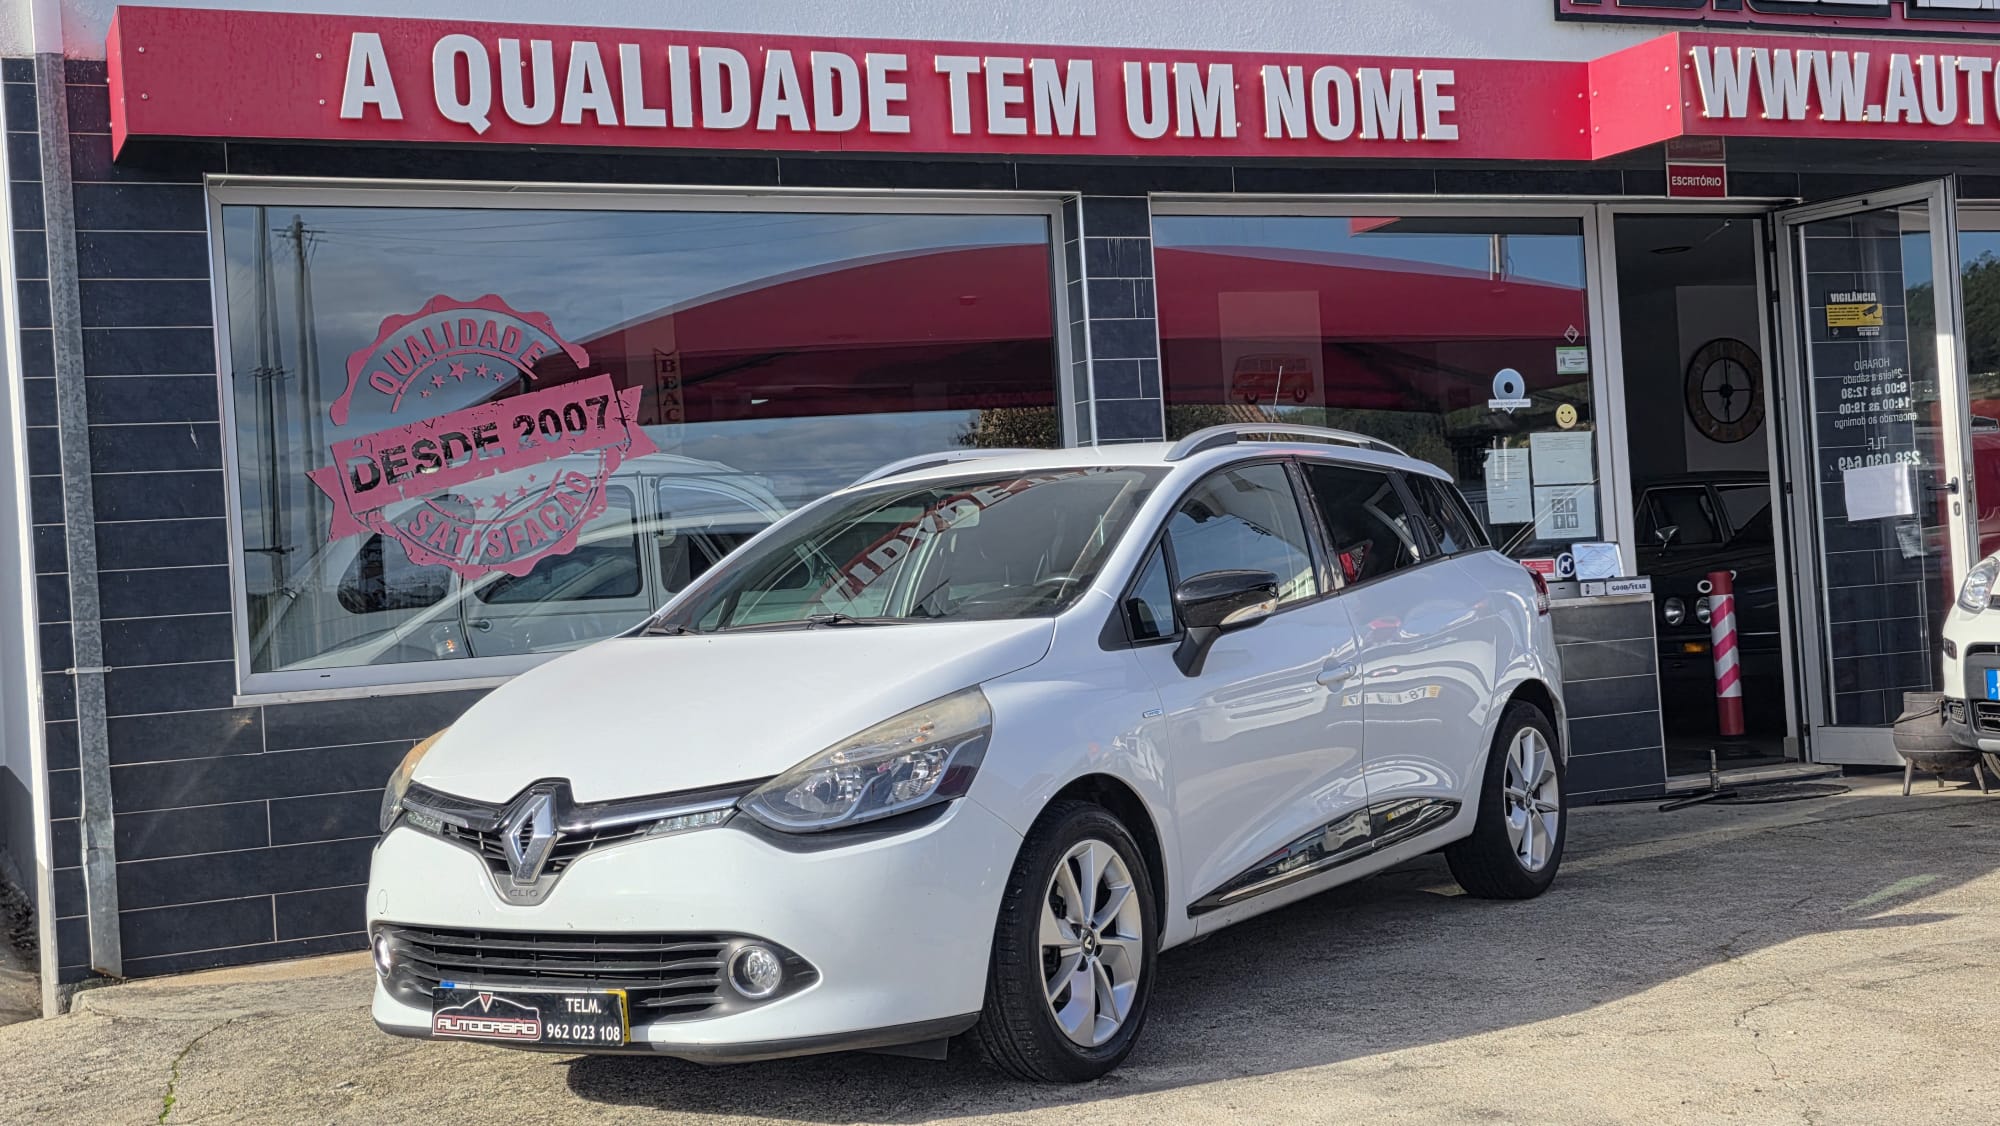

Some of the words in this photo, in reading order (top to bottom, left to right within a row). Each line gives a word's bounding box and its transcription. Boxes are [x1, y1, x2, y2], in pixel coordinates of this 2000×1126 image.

[339, 31, 404, 120] A
[432, 33, 911, 135] QUALIDADE
[934, 55, 1097, 136] TEM
[1123, 61, 1238, 139] UM
[1262, 64, 1459, 141] NOME
[1692, 46, 2000, 126] WWW.AUT
[1671, 174, 1722, 186] ESCRITÓRIO
[1830, 291, 1877, 302] VIGILÂNCIA
[369, 318, 548, 395] QUALIDADE
[347, 421, 506, 495] DESDE
[512, 396, 610, 449] 2007
[510, 889, 538, 897] CLIO
[565, 998, 602, 1013] TELM.
[547, 1024, 569, 1039] 962
[573, 1025, 595, 1039] 023
[600, 1026, 620, 1041] 108
